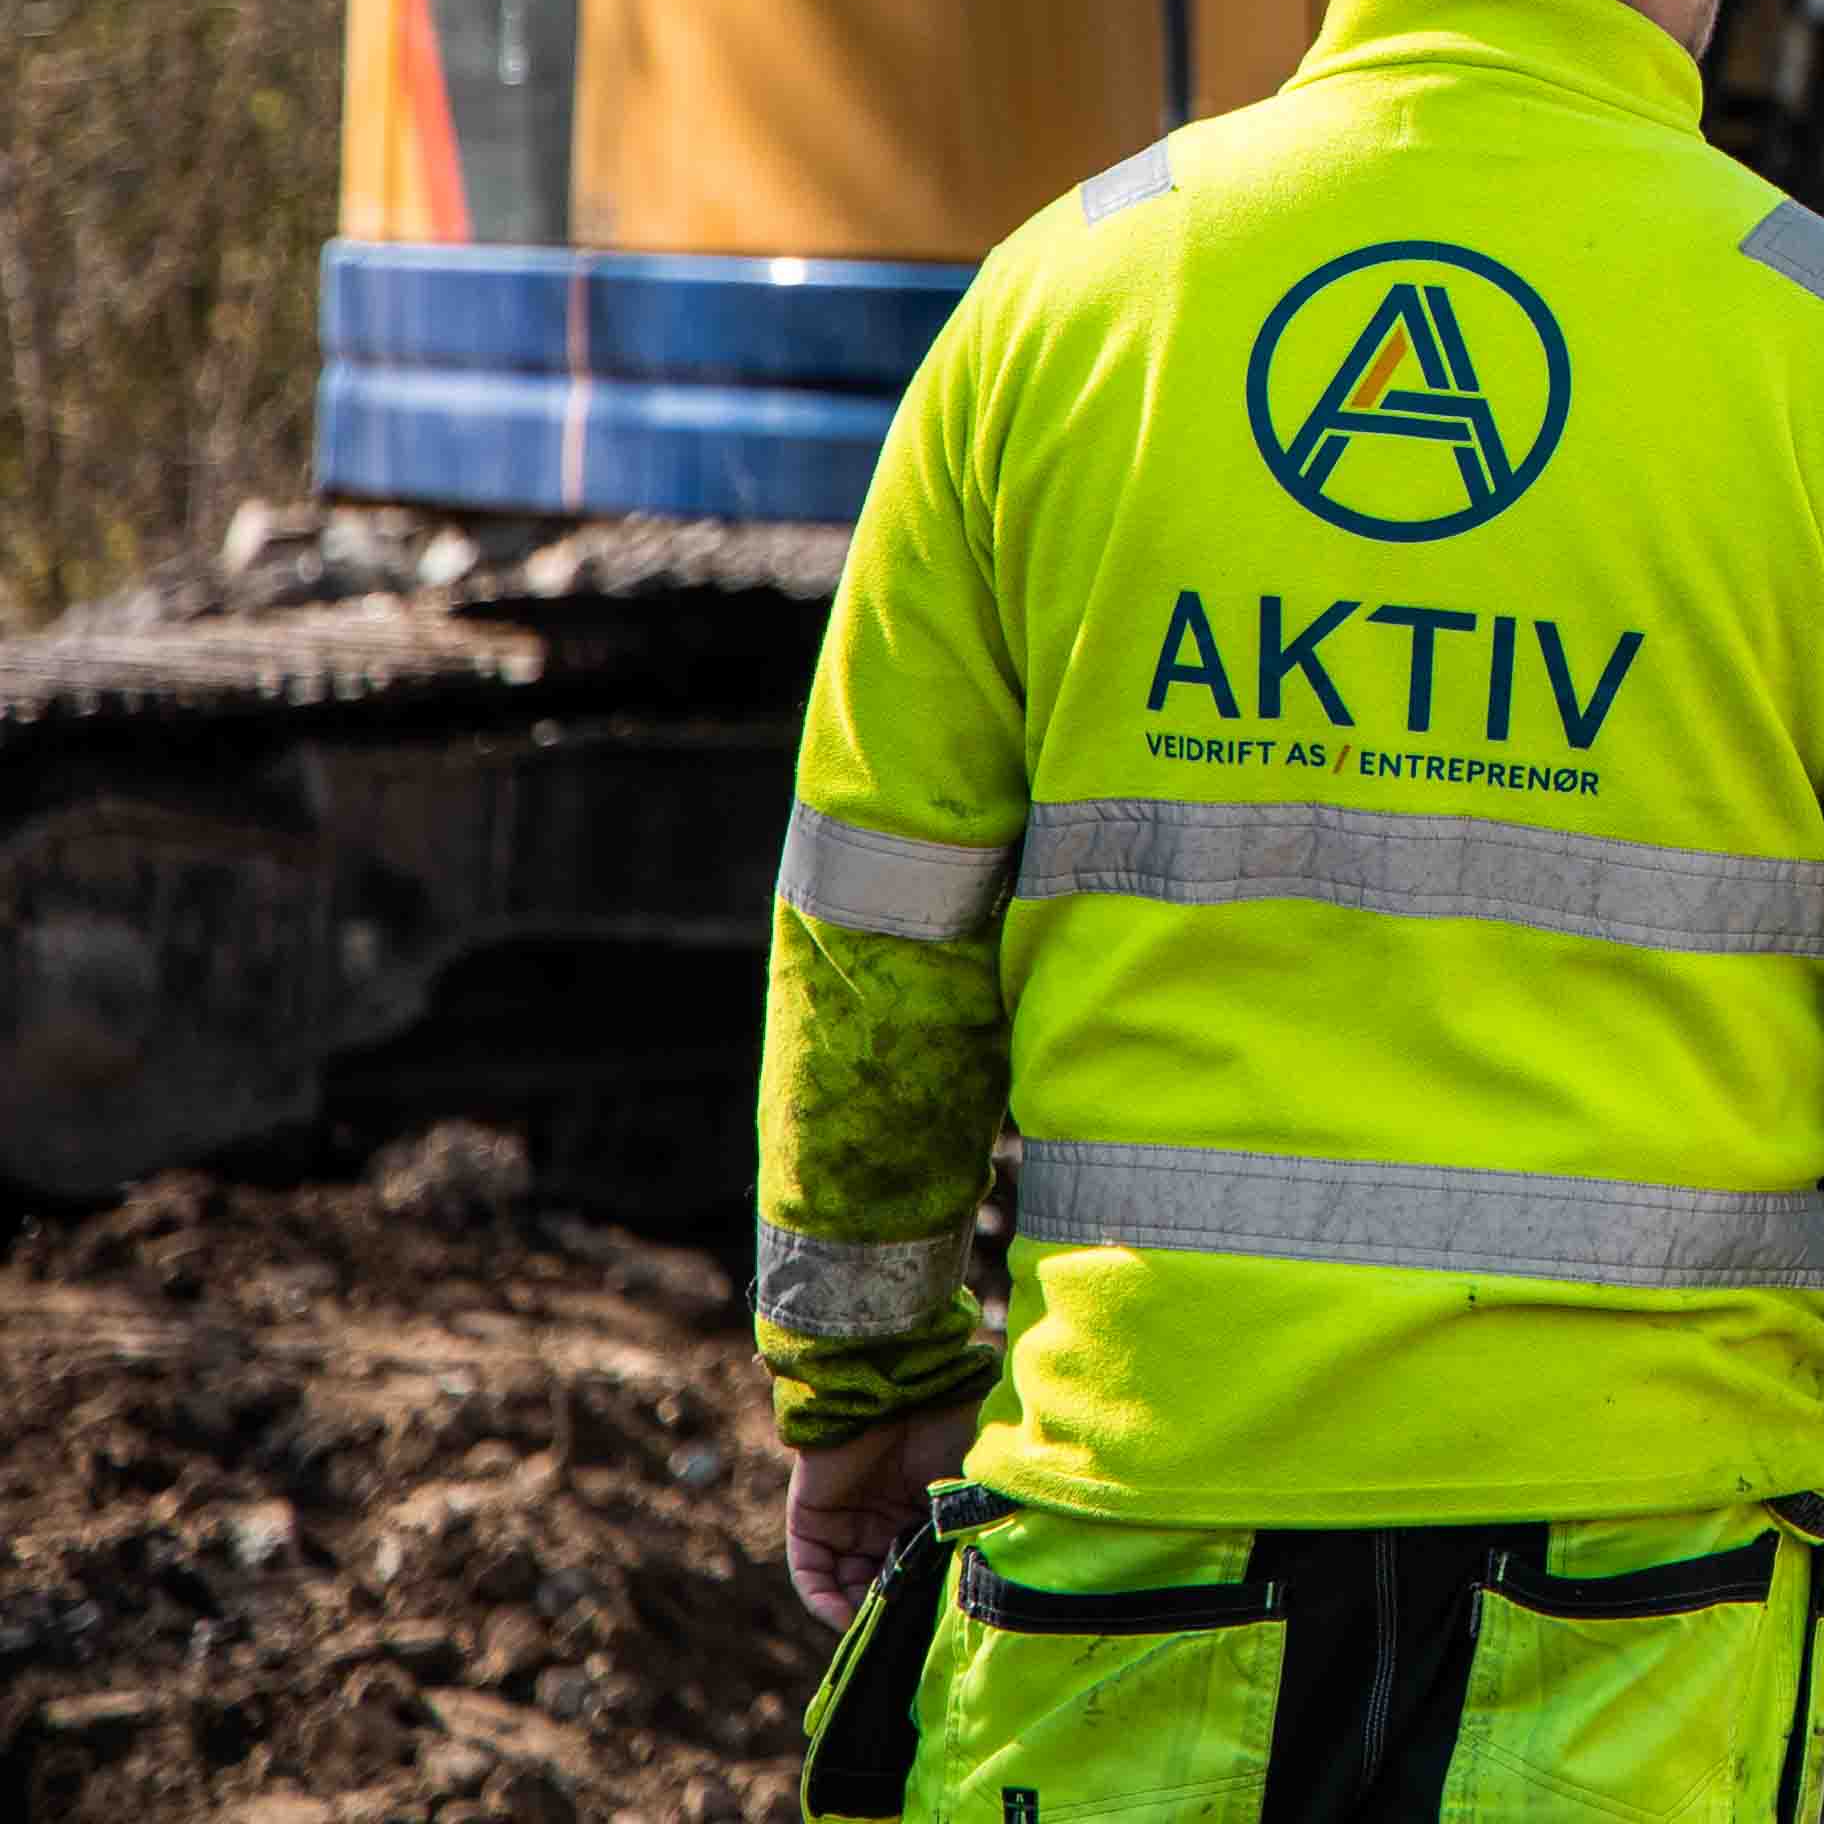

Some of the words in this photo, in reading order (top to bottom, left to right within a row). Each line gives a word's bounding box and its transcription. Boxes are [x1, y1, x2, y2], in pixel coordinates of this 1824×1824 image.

[1146, 590, 1645, 750] AKTIV
[1145, 732, 1276, 766] VEIDRIFT
[1285, 742, 1326, 768] AS
[1358, 750, 1600, 796] ENTREPRENØR
